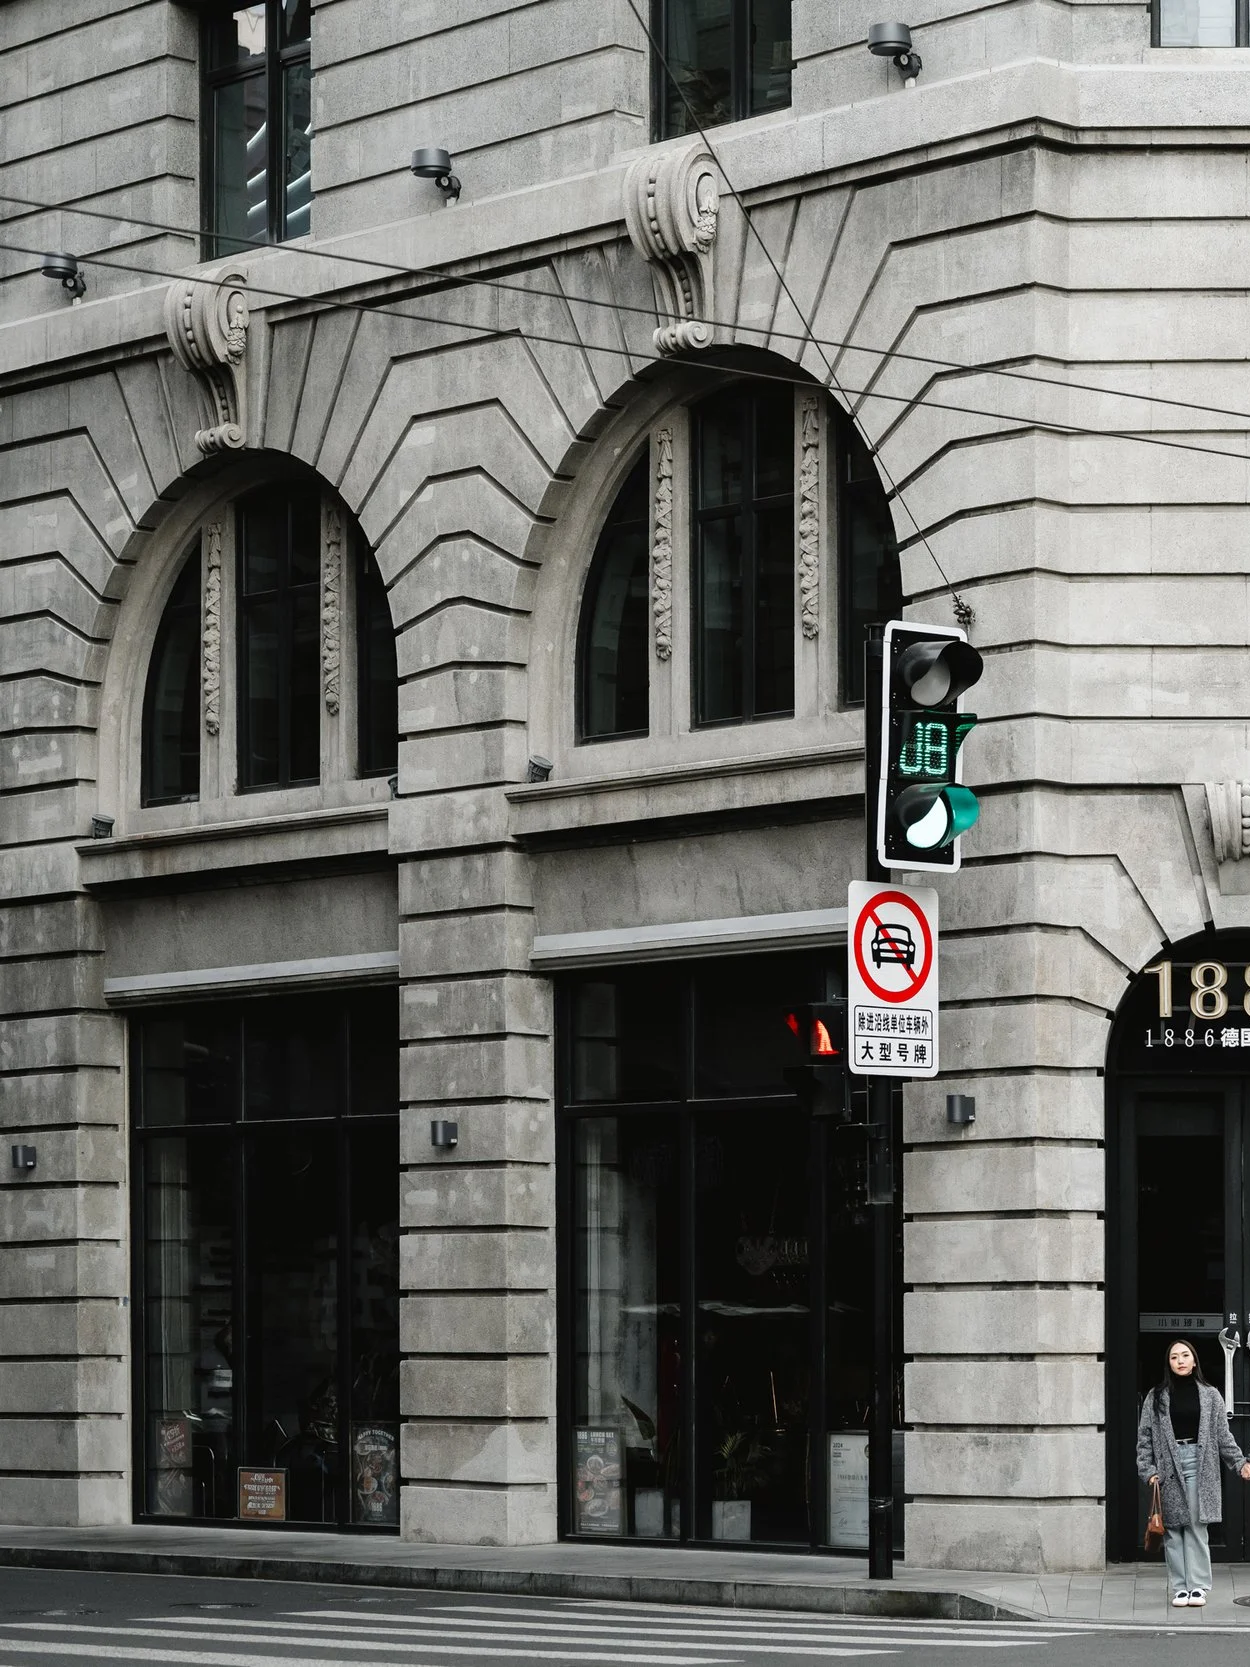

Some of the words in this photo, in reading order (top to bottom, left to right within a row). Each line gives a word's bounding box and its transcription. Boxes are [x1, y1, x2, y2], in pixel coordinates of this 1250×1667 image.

[858, 1012, 929, 1035] 除进沿线单位车辆外
[861, 1041, 927, 1064] 大型号牌
[1229, 1312, 1237, 1320] 拉
[357, 1430, 372, 1441] HAPPY
